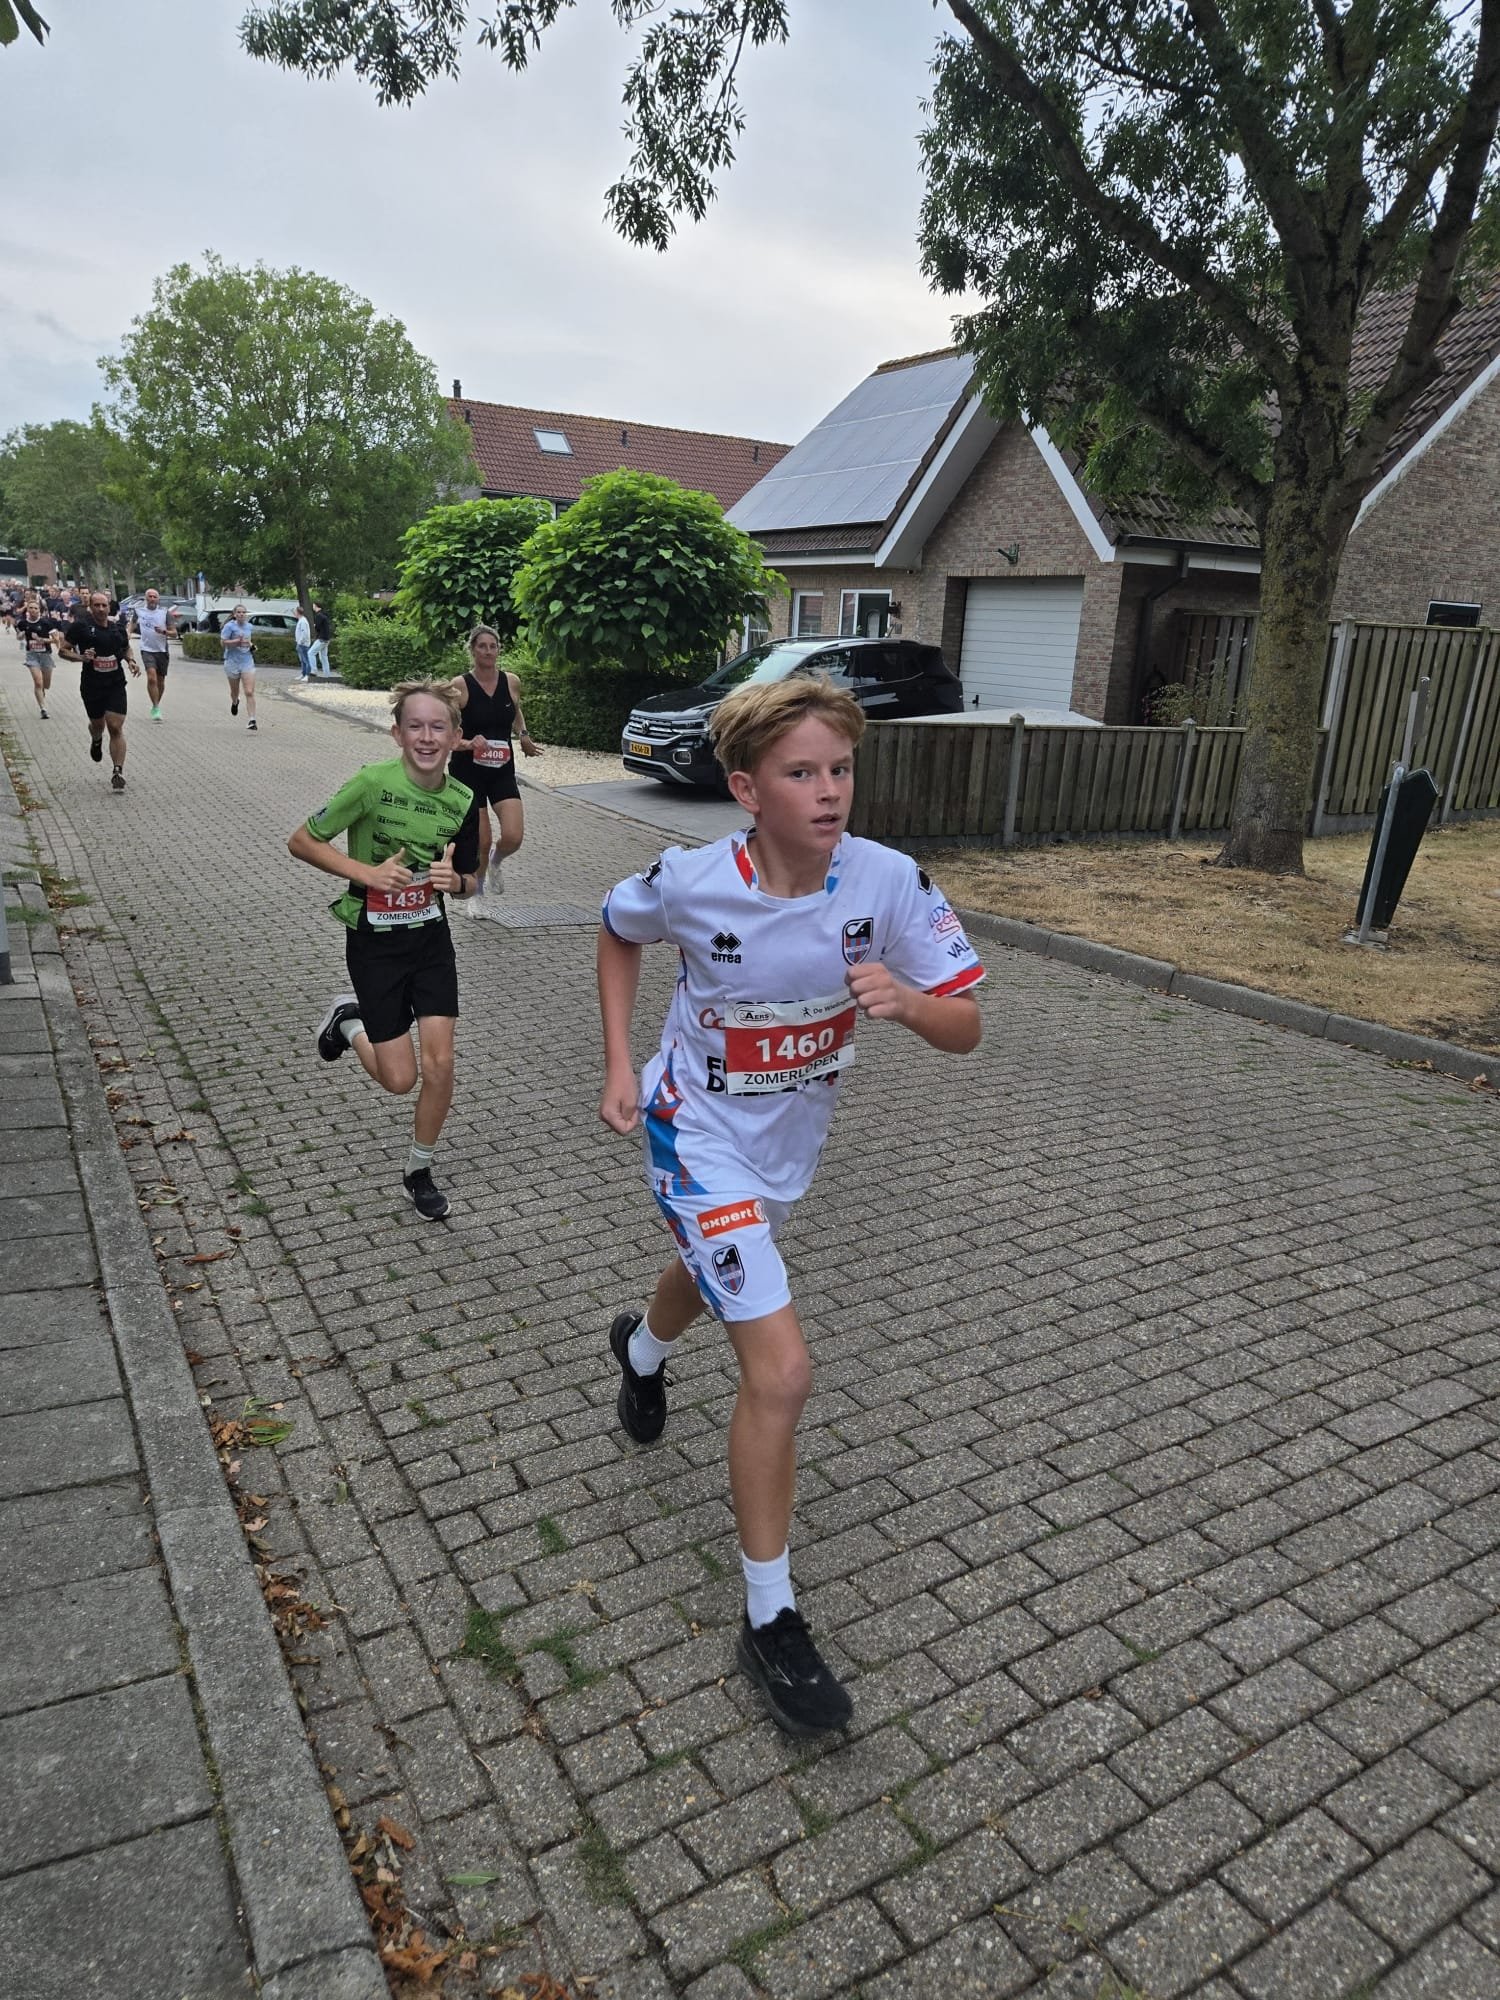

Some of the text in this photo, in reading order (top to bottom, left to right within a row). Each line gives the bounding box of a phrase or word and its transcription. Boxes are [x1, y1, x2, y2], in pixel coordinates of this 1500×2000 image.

[384, 890, 425, 908] 1433
[376, 908, 431, 921] ZOMERLOPEN
[711, 952, 742, 964] errea
[756, 1027, 834, 1063] 1460
[744, 1052, 839, 1085] ZOMERLOPEN
[701, 1208, 753, 1230] expert
